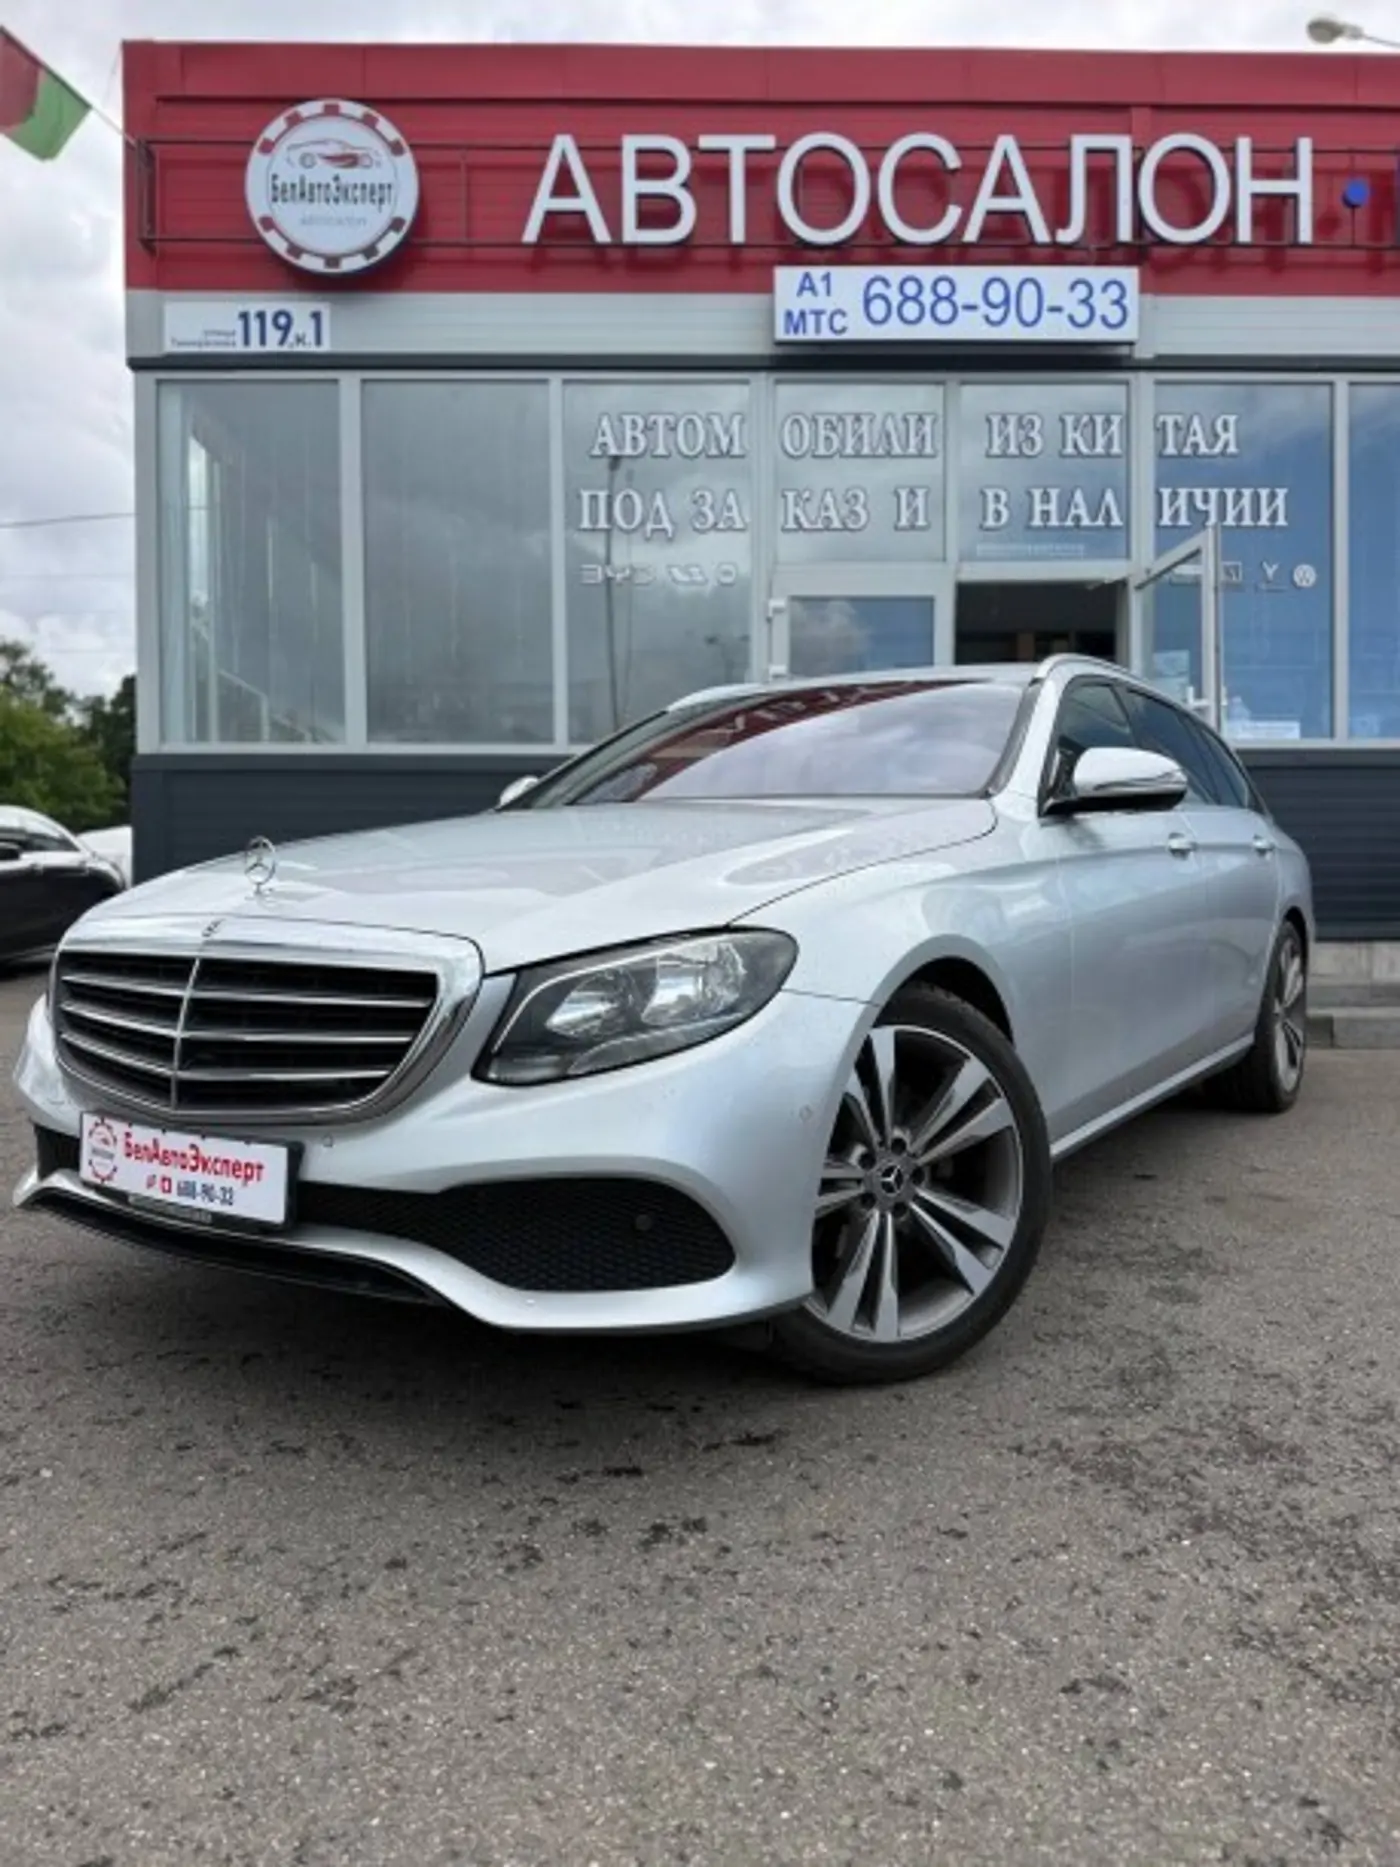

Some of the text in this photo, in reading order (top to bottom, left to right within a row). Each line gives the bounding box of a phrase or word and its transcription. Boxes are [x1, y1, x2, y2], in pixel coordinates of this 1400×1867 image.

[270, 173, 393, 213] БелАвтоЭксперт
[521, 131, 1315, 246] АВТОСАЛОН
[796, 271, 833, 298] A1
[861, 274, 1130, 331] 688-90-33
[783, 309, 848, 336] МТС
[985, 413, 1044, 457] ИЗ
[577, 487, 676, 541] ПОД
[894, 486, 930, 531] И
[979, 487, 1011, 531] В
[123, 1131, 265, 1186] БелАвтоЭксперт
